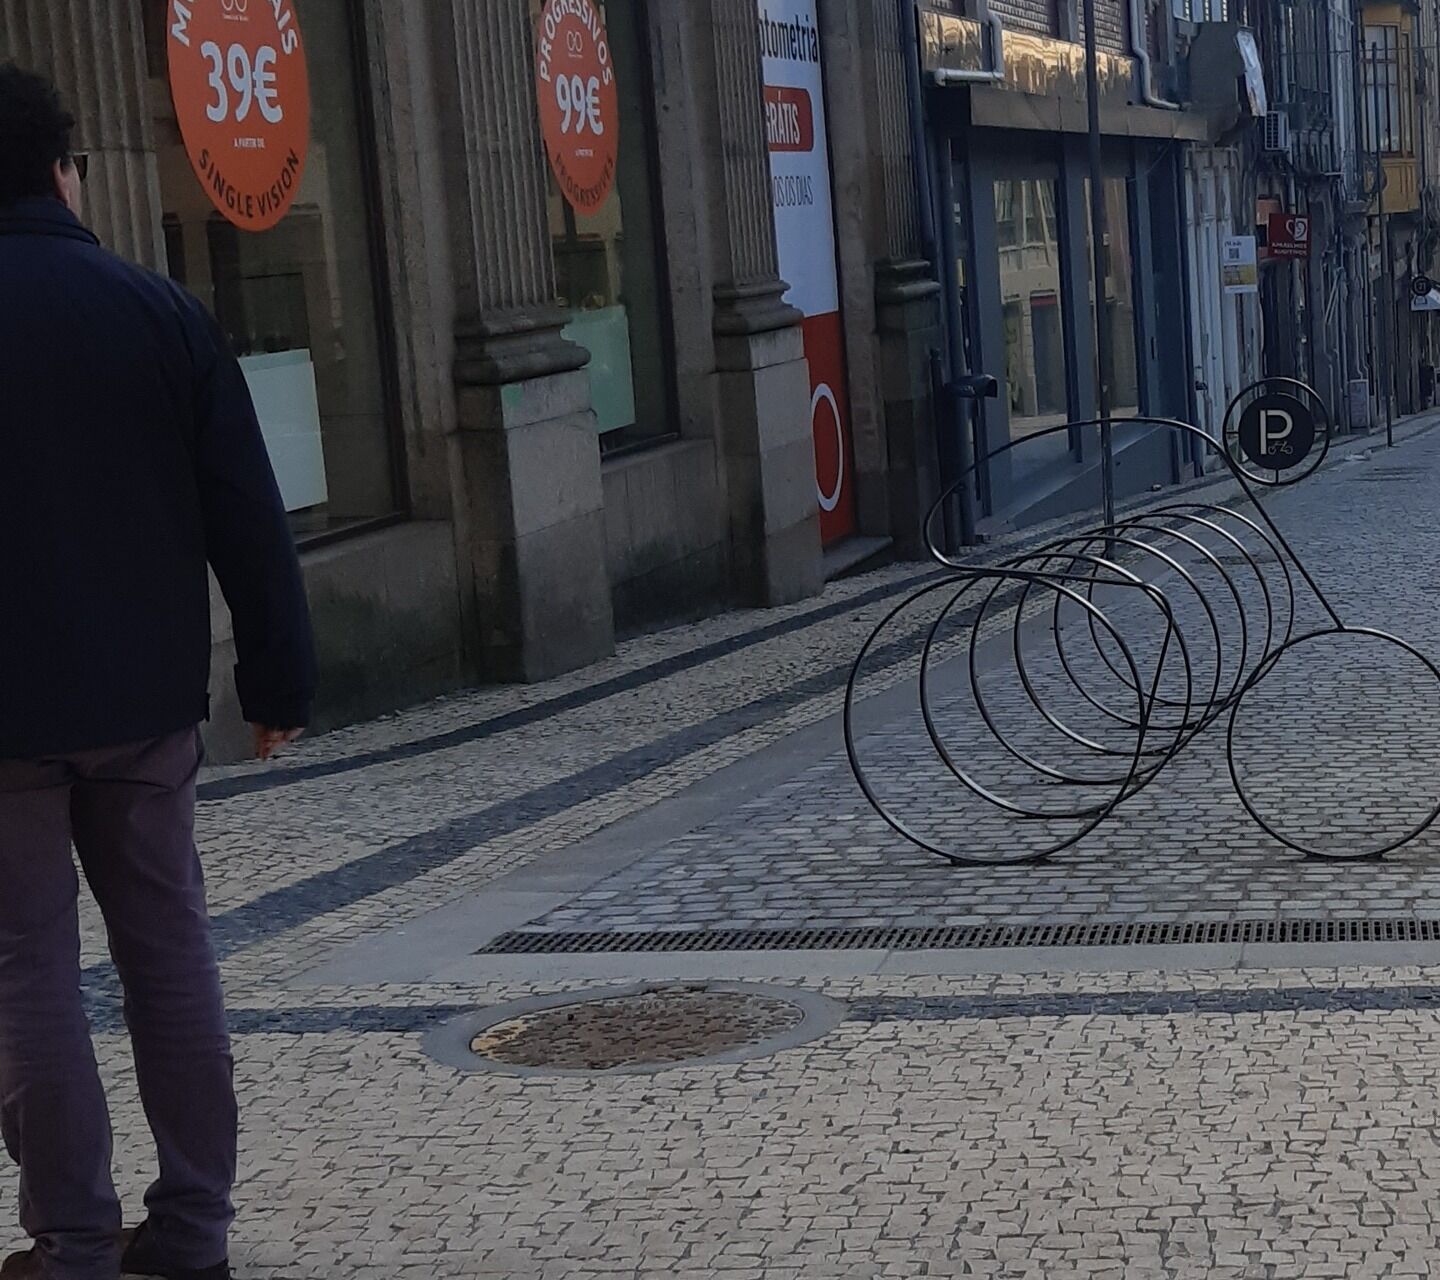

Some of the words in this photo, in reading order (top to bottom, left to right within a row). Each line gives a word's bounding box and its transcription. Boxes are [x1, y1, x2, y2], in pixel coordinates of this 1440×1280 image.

[200, 40, 283, 124] 39€
[556, 73, 604, 135] 99€
[199, 148, 253, 219] SINGLE
[257, 148, 299, 217] VISION
[1260, 409, 1294, 455] P
